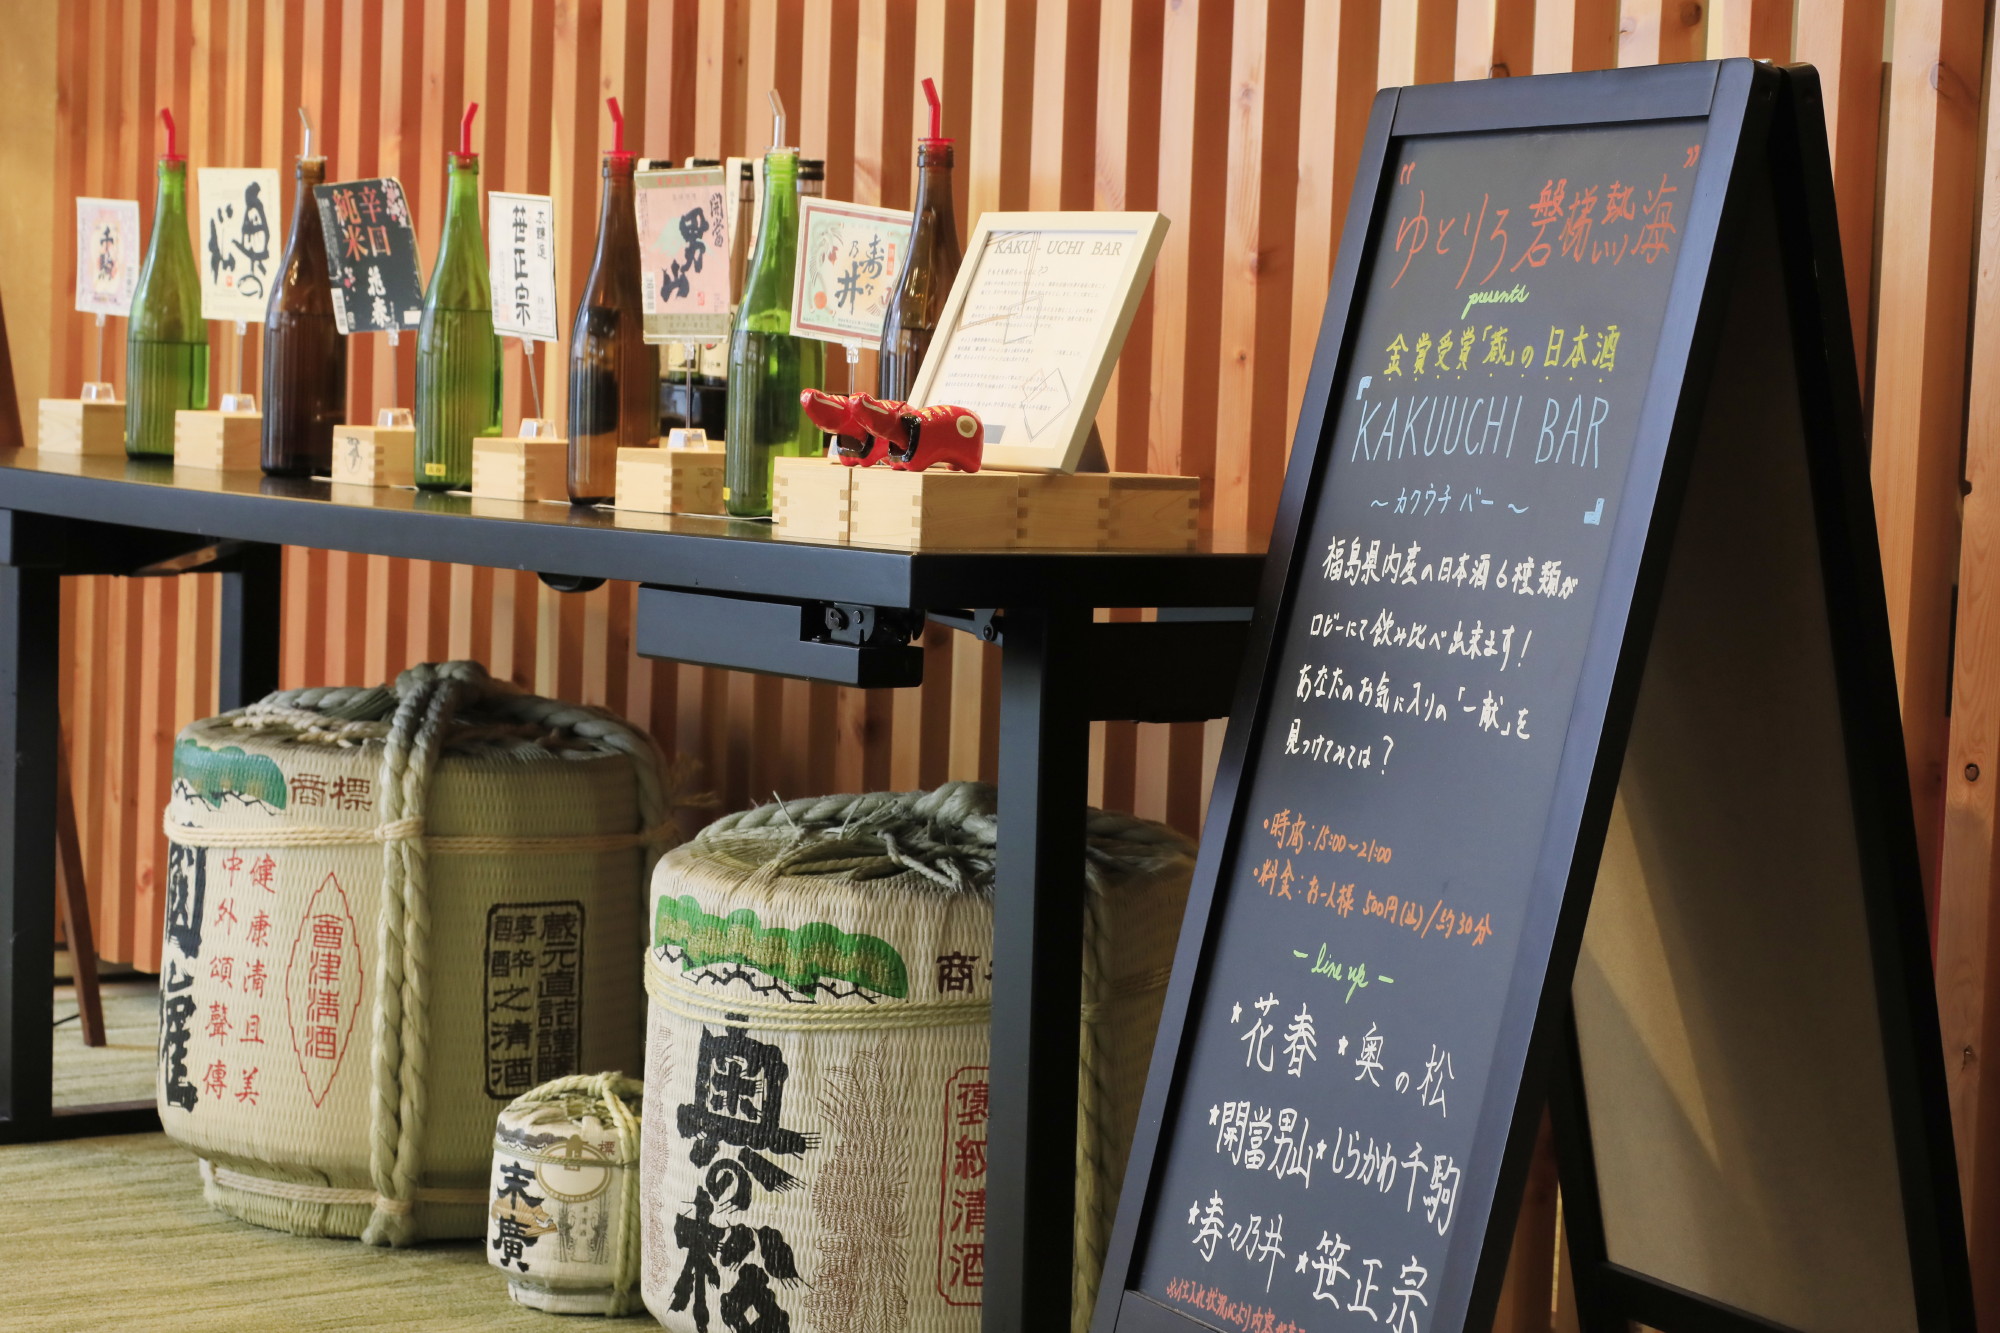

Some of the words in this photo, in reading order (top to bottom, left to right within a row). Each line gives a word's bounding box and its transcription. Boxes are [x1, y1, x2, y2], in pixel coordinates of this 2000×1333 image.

[1091, 242, 1122, 256] BAR
[290, 773, 373, 812] 商標
[1241, 992, 1318, 1078] 花春
[1355, 1022, 1455, 1118] 奥の松
[1311, 1229, 1428, 1333] 笹正宗
